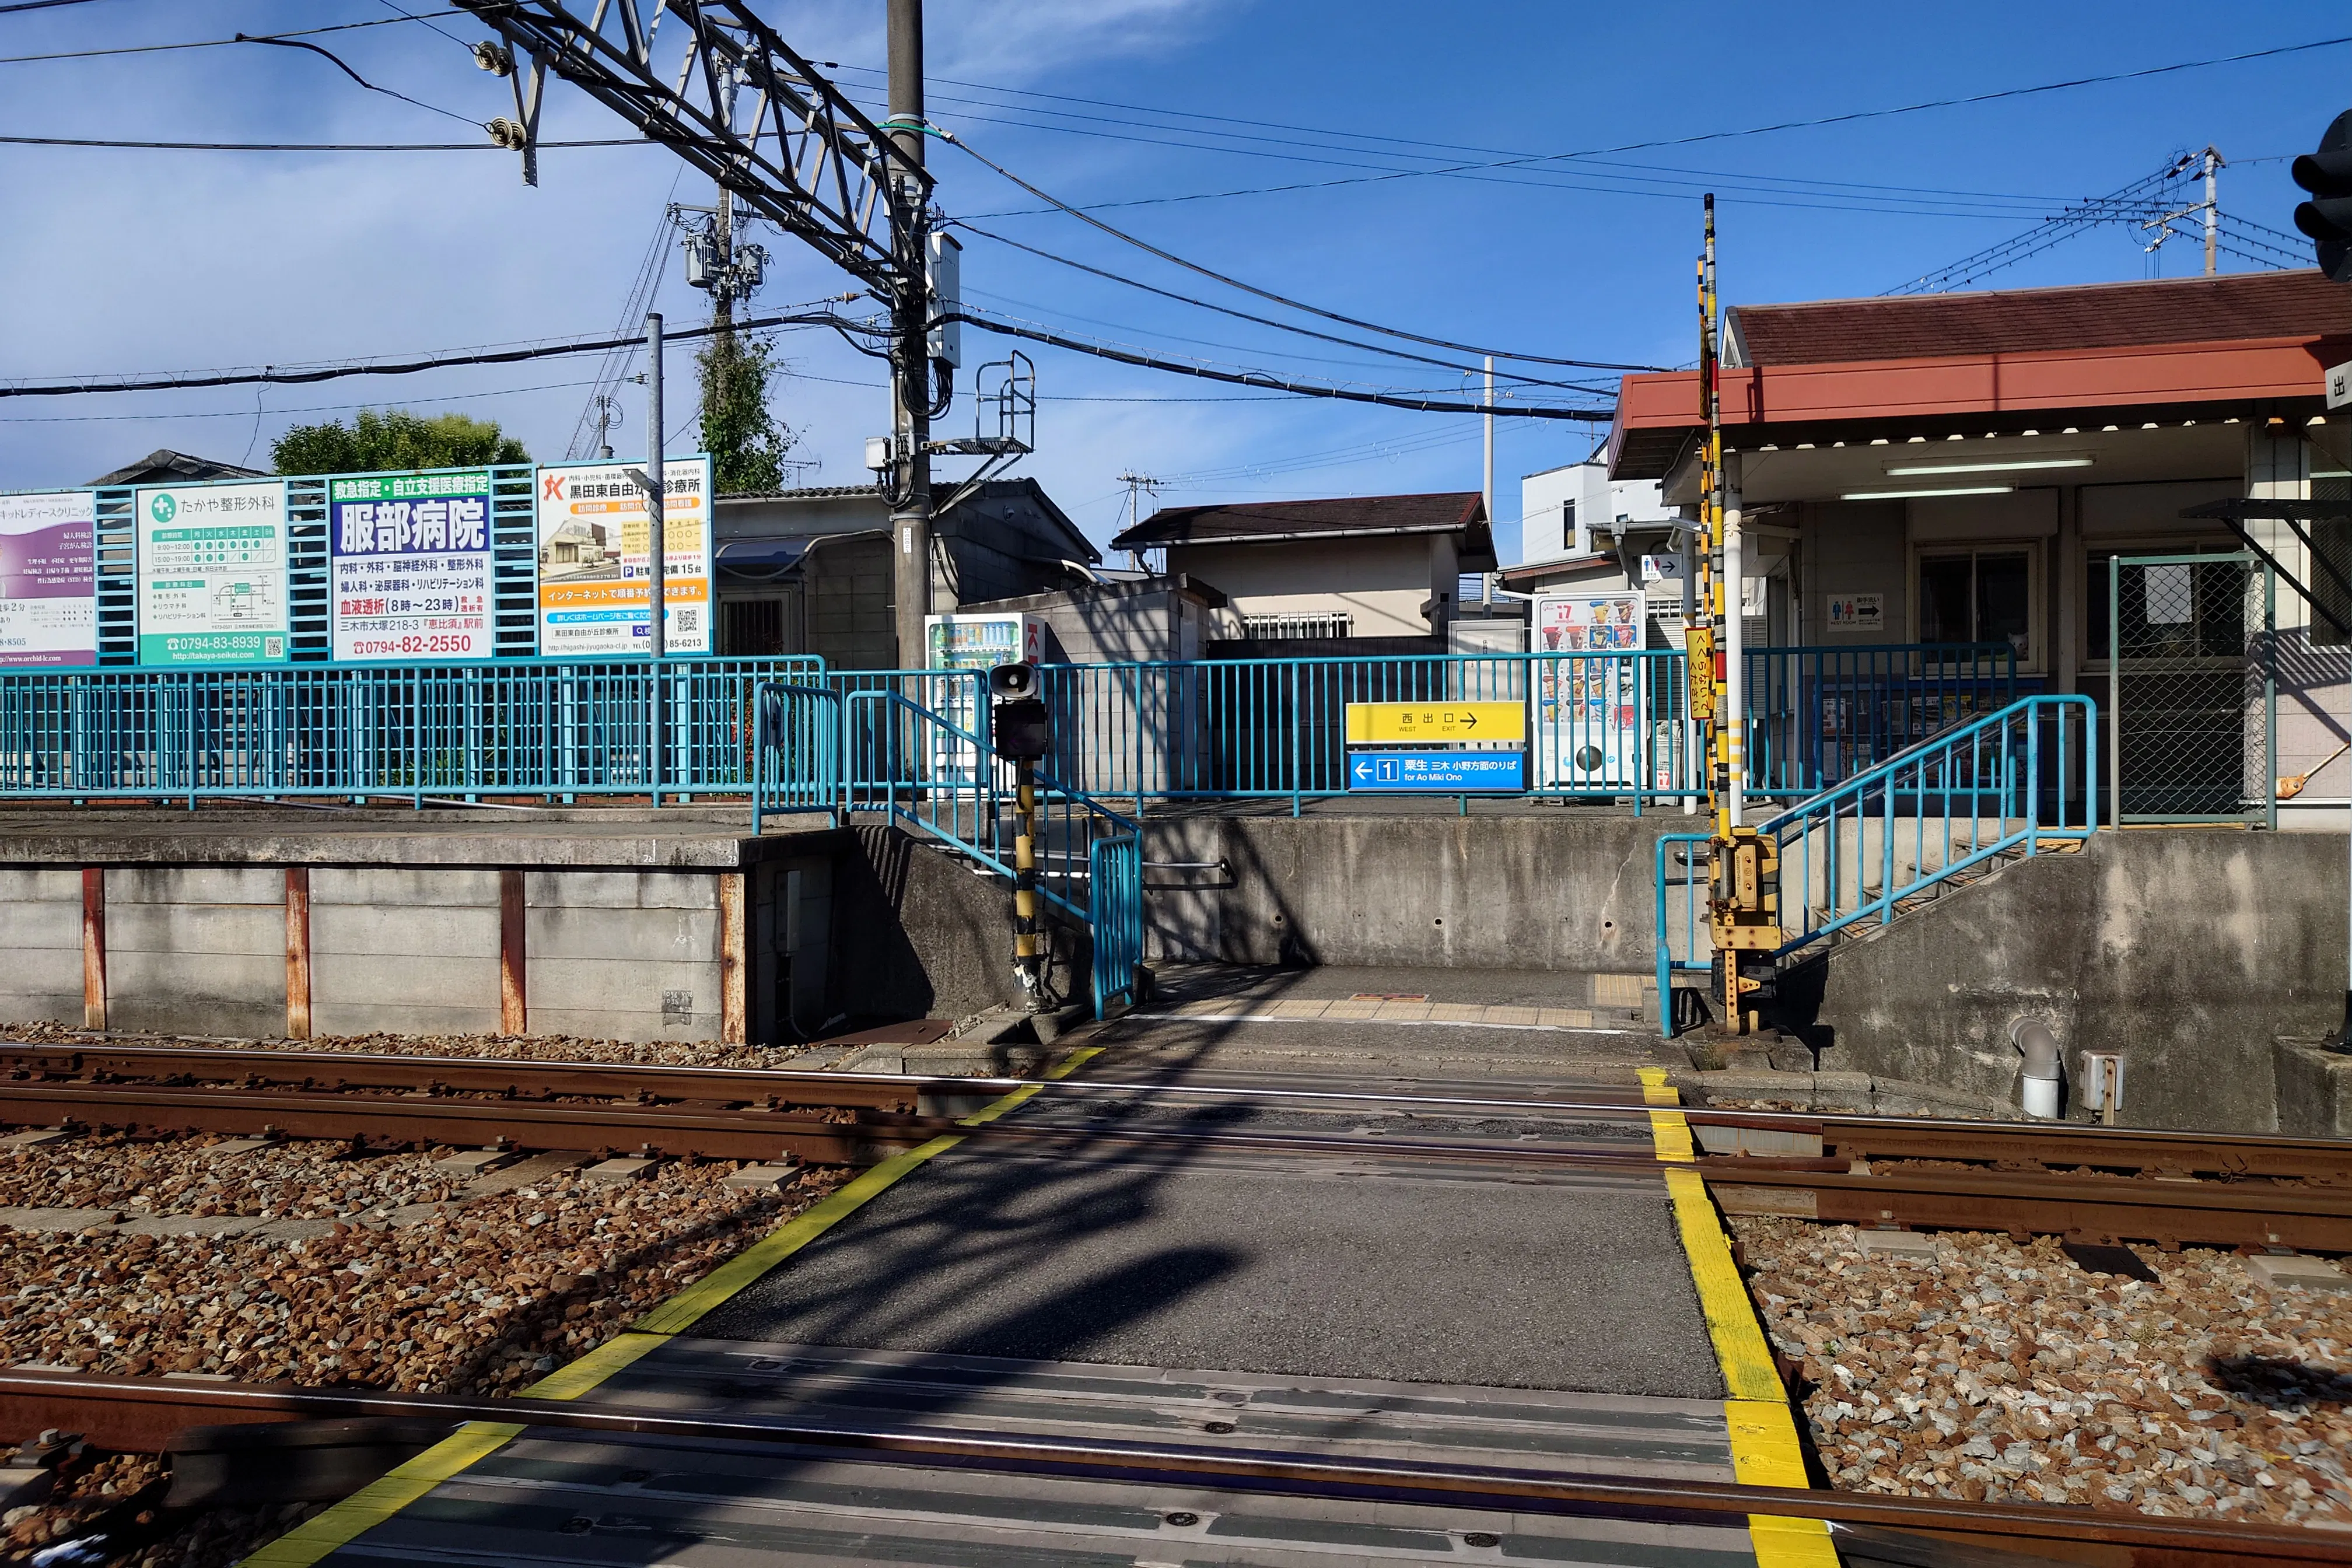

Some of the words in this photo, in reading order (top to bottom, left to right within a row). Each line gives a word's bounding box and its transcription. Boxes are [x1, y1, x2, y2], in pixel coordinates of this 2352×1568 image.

[334, 475, 488, 499] 救急指定・自立支援医療指定
[181, 495, 275, 513] たかや整形外科
[340, 498, 485, 554] 服部病院
[555, 628, 619, 637] 黒田東自由が丘診療所
[181, 636, 261, 650] 0794-83-8939
[366, 635, 471, 653] 0794-82-2550
[173, 651, 254, 661] http://takaya-seikei.com
[1690, 662, 1699, 712] ください
[1405, 759, 1428, 771] 粟生
[1431, 761, 1450, 770] 三木
[1452, 760, 1517, 771] 小野方面のりば
